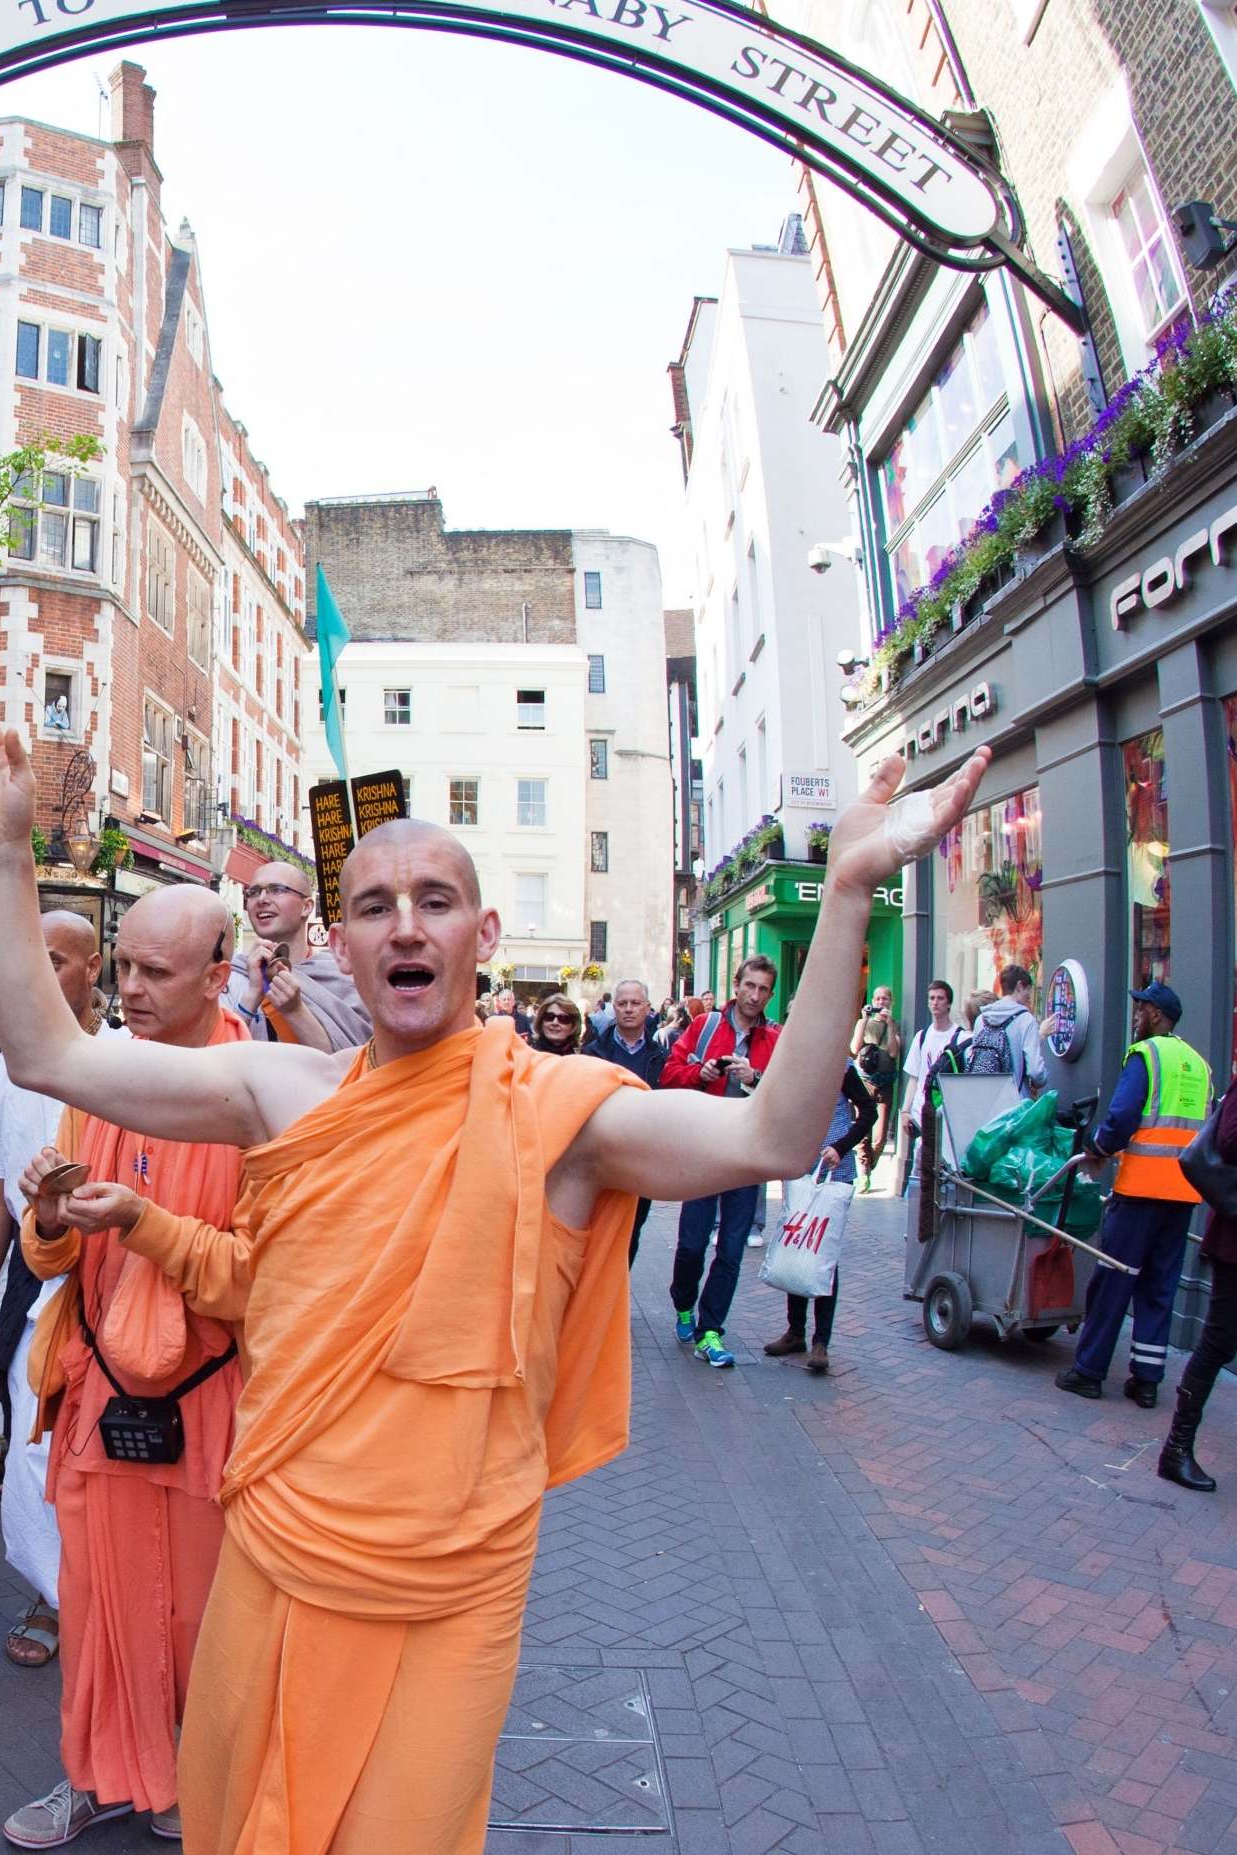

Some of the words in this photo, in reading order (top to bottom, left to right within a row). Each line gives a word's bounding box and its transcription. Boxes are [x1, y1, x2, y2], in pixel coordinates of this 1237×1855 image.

[731, 46, 953, 194] STREET
[790, 776, 830, 788] FOUBERTS
[791, 786, 815, 797] PLACE
[817, 787, 829, 798] W1
[315, 793, 341, 811] HARE
[356, 781, 397, 802] KRISHNA
[317, 809, 343, 827] HARE
[358, 799, 399, 819] KRISHNA
[319, 823, 353, 843] KRISHNA
[320, 841, 347, 860] HARE
[778, 1211, 831, 1255] H&M
